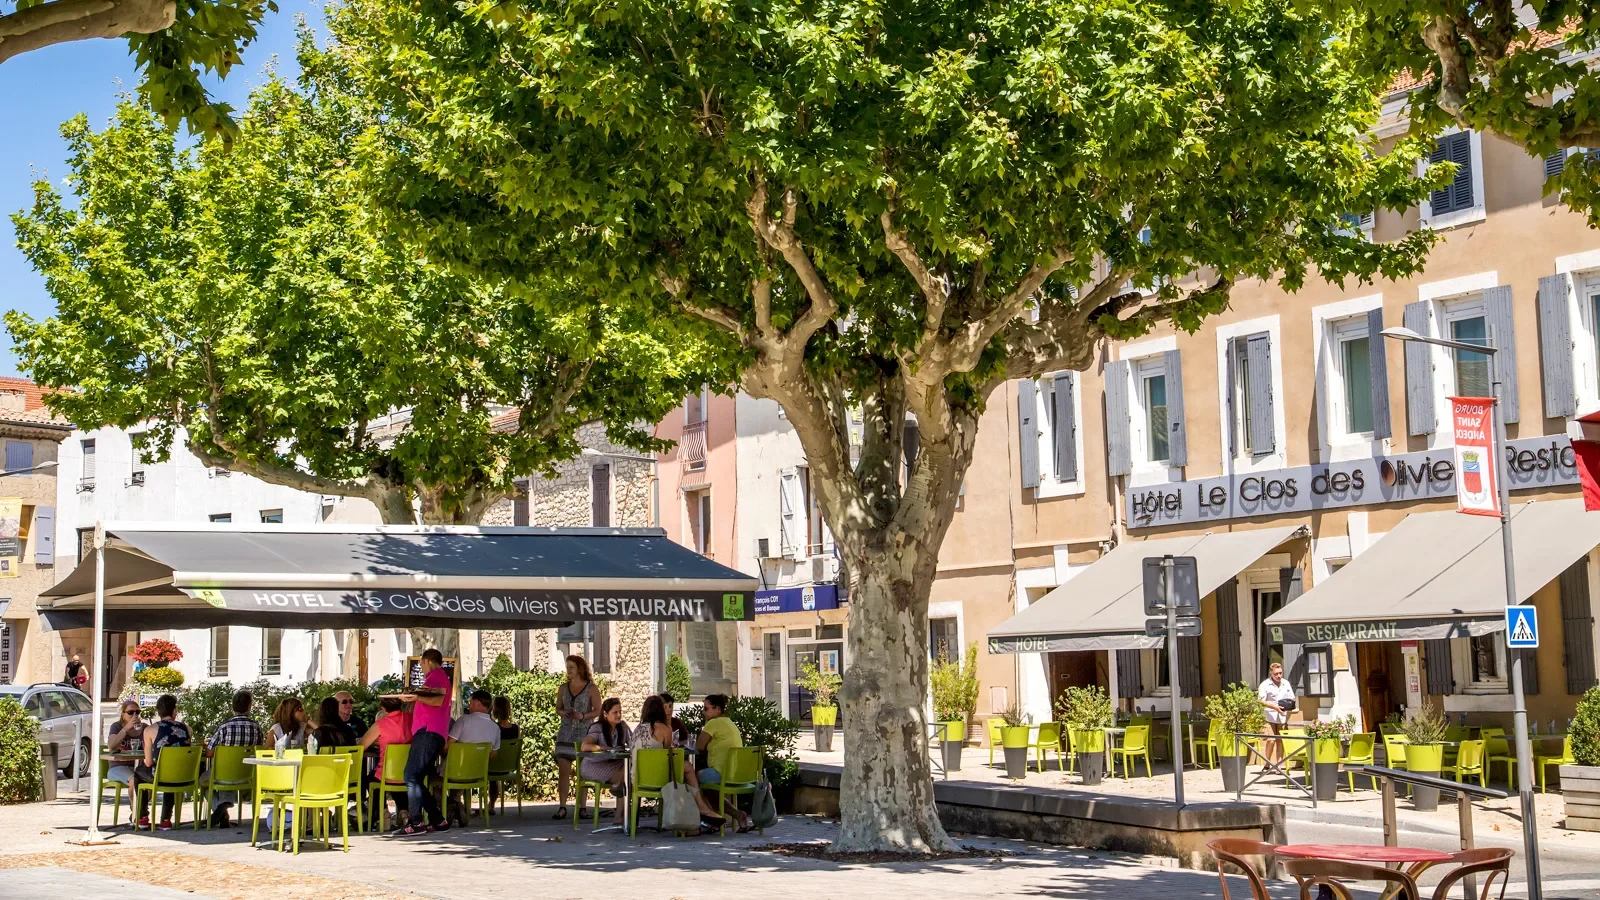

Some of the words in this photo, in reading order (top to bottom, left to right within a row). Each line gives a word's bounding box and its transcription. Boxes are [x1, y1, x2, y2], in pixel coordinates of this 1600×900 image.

[1132, 488, 1182, 515] Hôtel
[1198, 483, 1227, 507] Le
[1240, 476, 1298, 502] Clos
[1311, 468, 1365, 495] des
[252, 592, 334, 608] HOTEL
[355, 594, 383, 608] Le
[389, 594, 440, 611] Clos
[446, 596, 486, 613] des
[490, 596, 559, 615] Oliviers
[578, 598, 705, 617] RESTAURANT
[803, 594, 814, 604] gan
[1306, 622, 1397, 641] RESTAURANT
[1015, 637, 1049, 651] HOTEL
